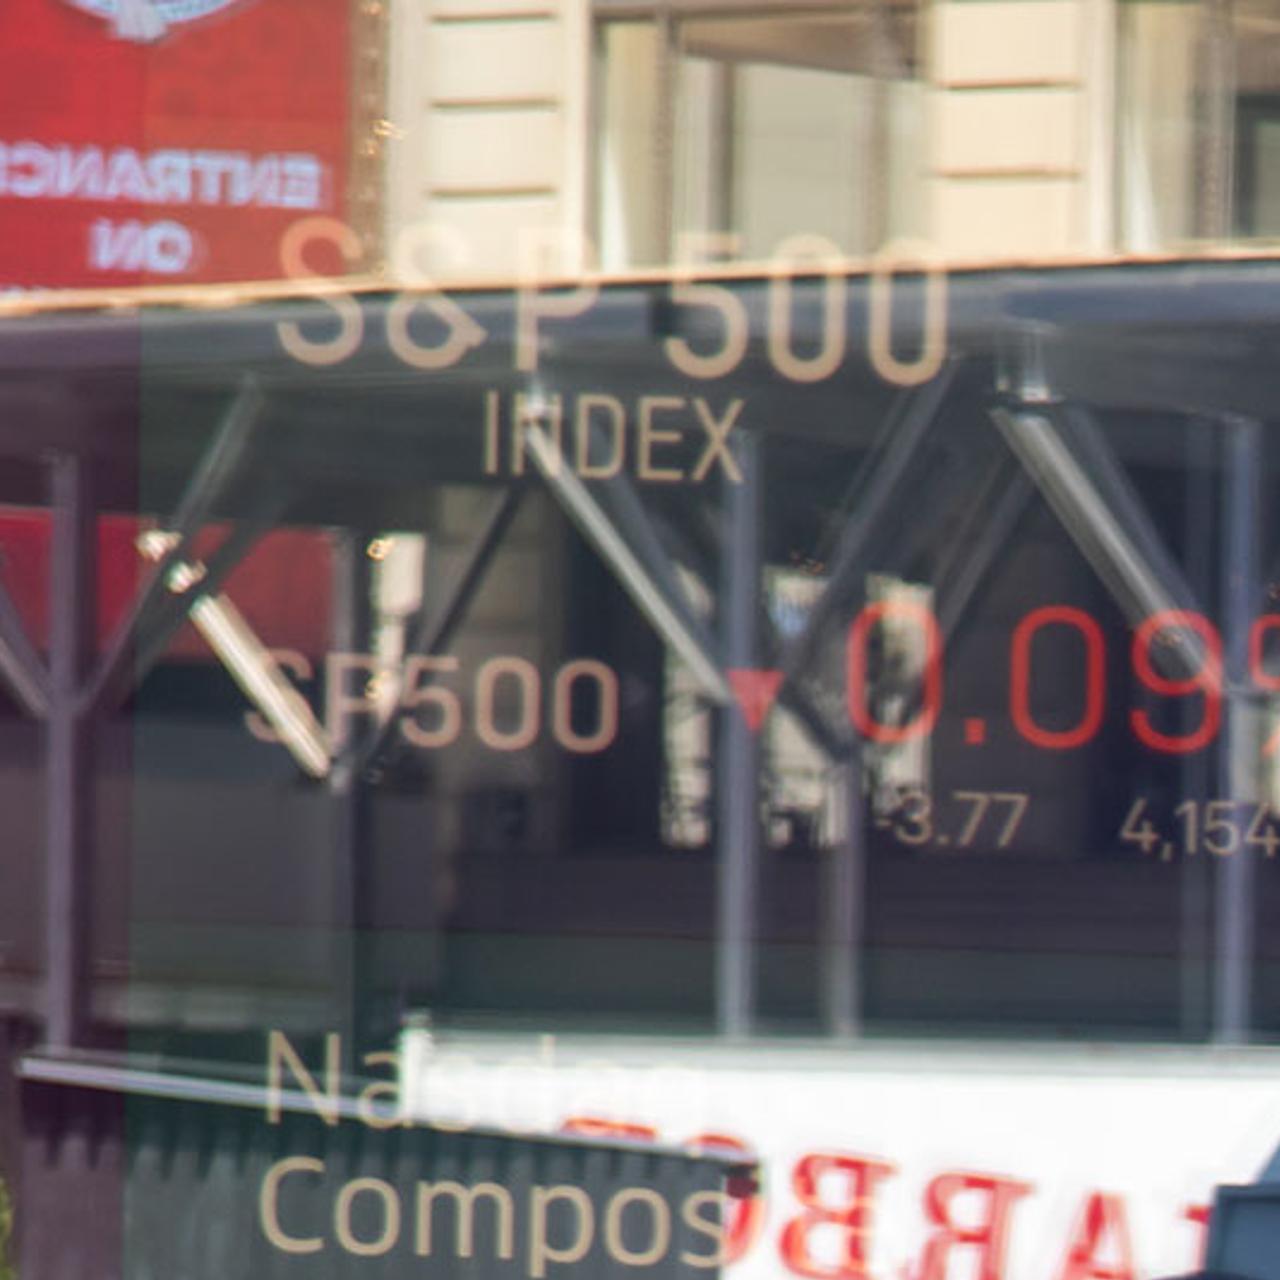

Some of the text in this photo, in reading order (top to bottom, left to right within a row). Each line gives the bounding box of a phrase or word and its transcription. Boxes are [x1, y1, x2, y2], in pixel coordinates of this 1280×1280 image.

[276, 217, 948, 387] S&P 500
[483, 391, 745, 484] INDEX
[875, 792, 1030, 848] -3.77
[259, 1156, 730, 1279] Compos
